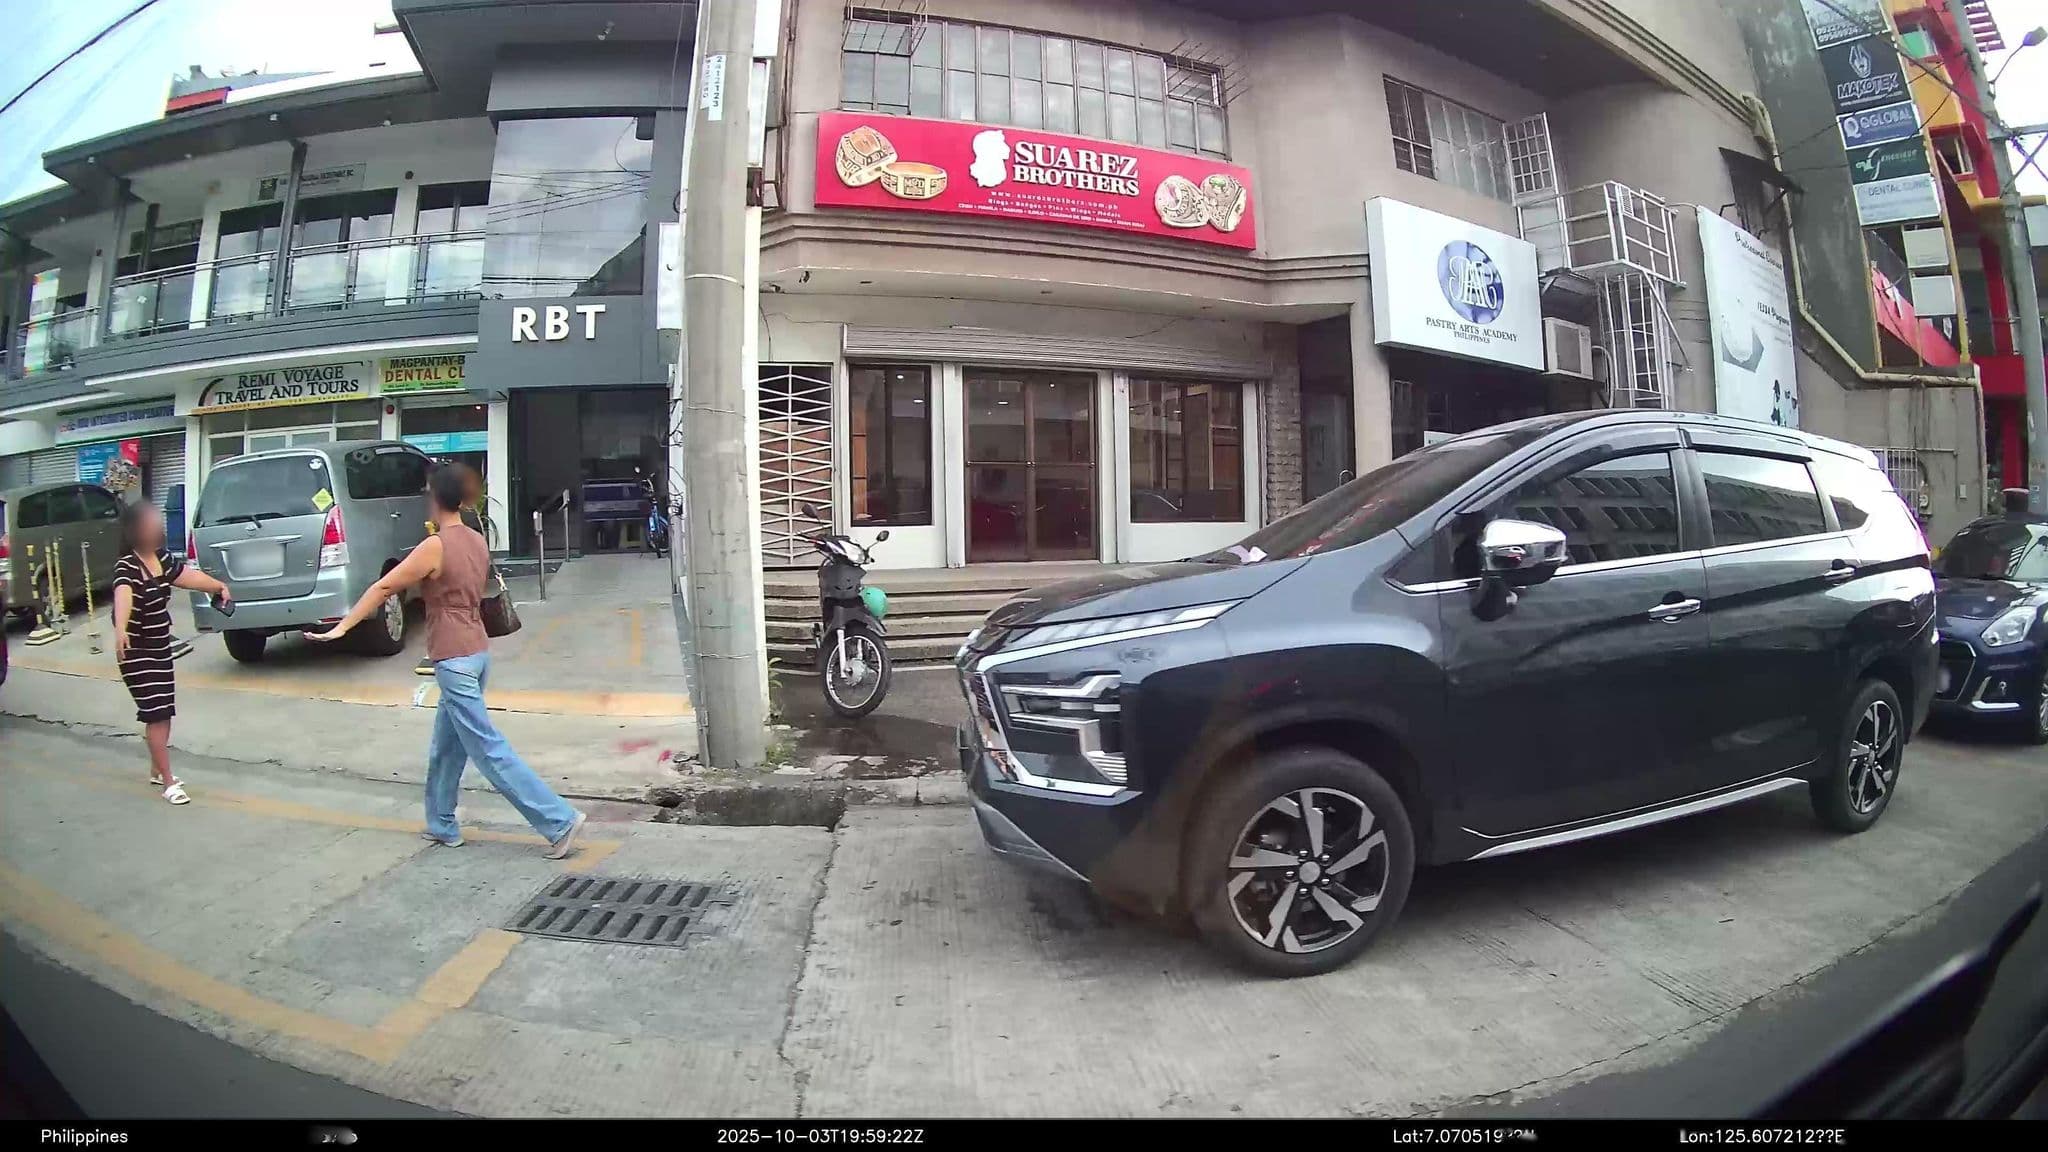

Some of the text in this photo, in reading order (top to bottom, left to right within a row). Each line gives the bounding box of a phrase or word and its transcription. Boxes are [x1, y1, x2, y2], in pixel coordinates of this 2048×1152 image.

[1014, 141, 1139, 179] SUAREZ
[1013, 164, 1140, 197] BROTHERS
[512, 304, 606, 342] RBT
[1426, 316, 1518, 343] PASTRY ARTS ACADEMY
[1453, 331, 1491, 344] PHILIPPINES
[238, 366, 343, 390] REMI VOYAGE
[384, 368, 442, 383] DENTAL
[215, 388, 267, 405] TRAVEL
[269, 384, 303, 400] AND
[306, 379, 359, 396] TOURS
